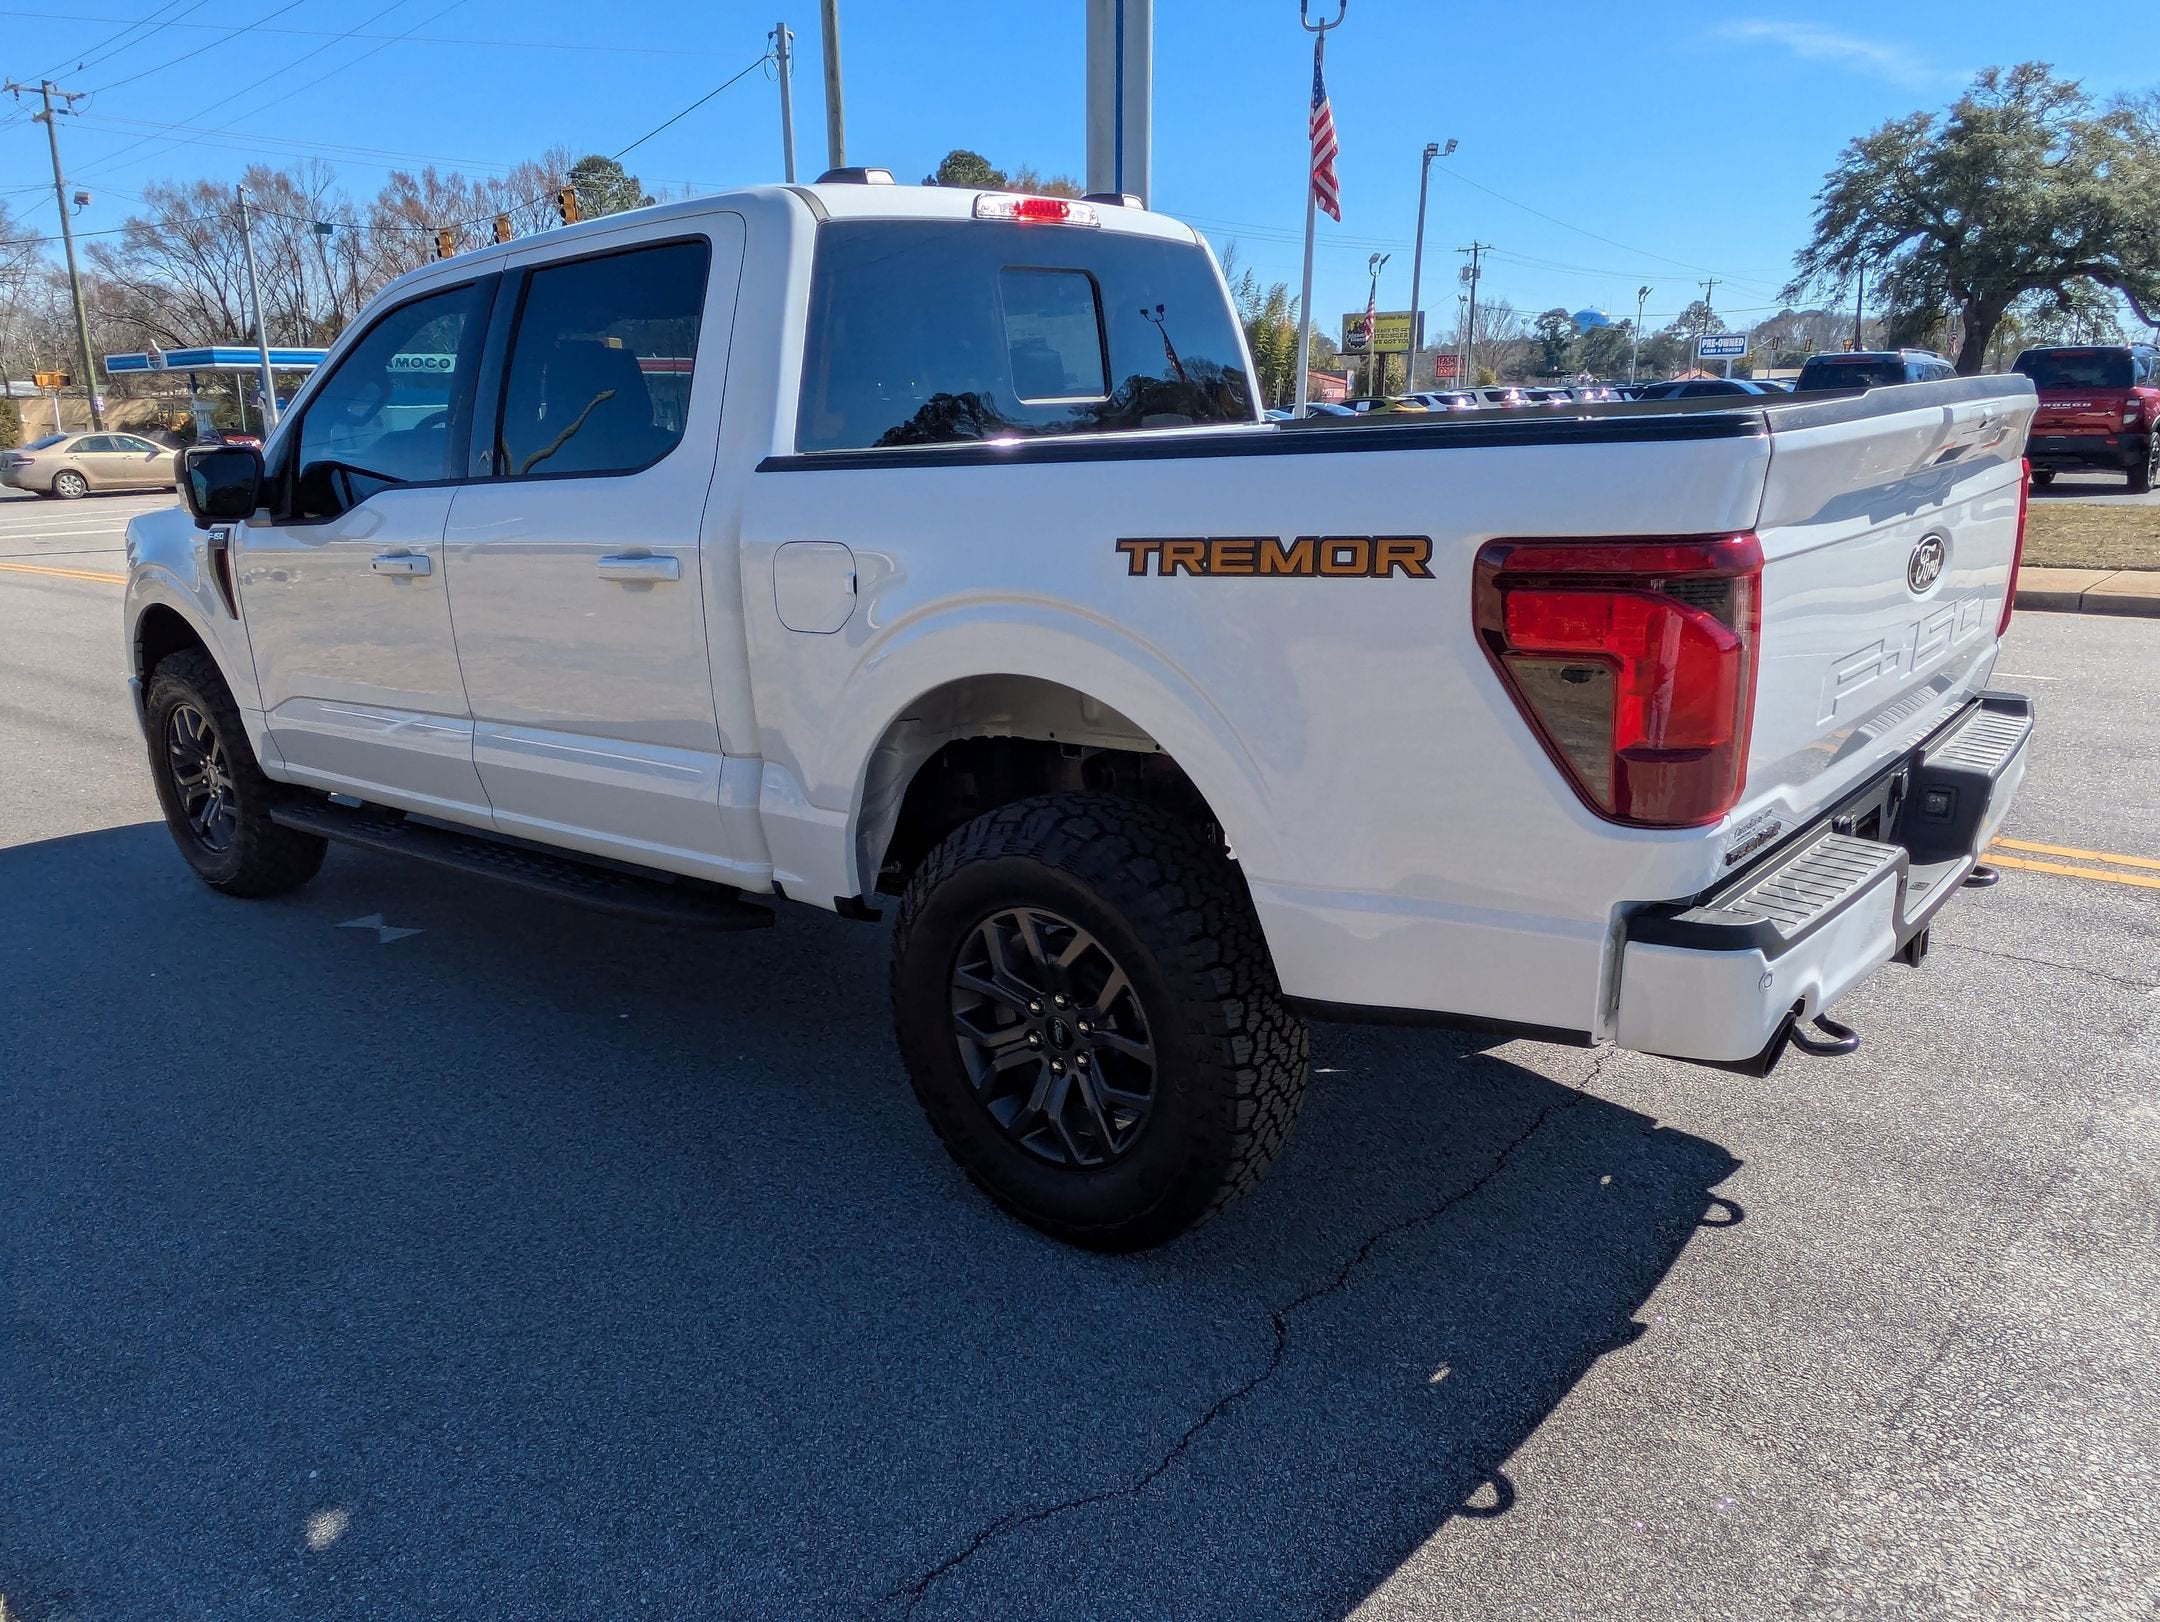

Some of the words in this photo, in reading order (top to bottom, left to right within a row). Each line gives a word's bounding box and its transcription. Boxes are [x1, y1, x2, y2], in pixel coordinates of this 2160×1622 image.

[1702, 337, 1744, 348] PRE-OWNED
[1115, 535, 1437, 579] TREMOR
[1914, 541, 1943, 586] Ford
[1816, 586, 1987, 726] F-150
